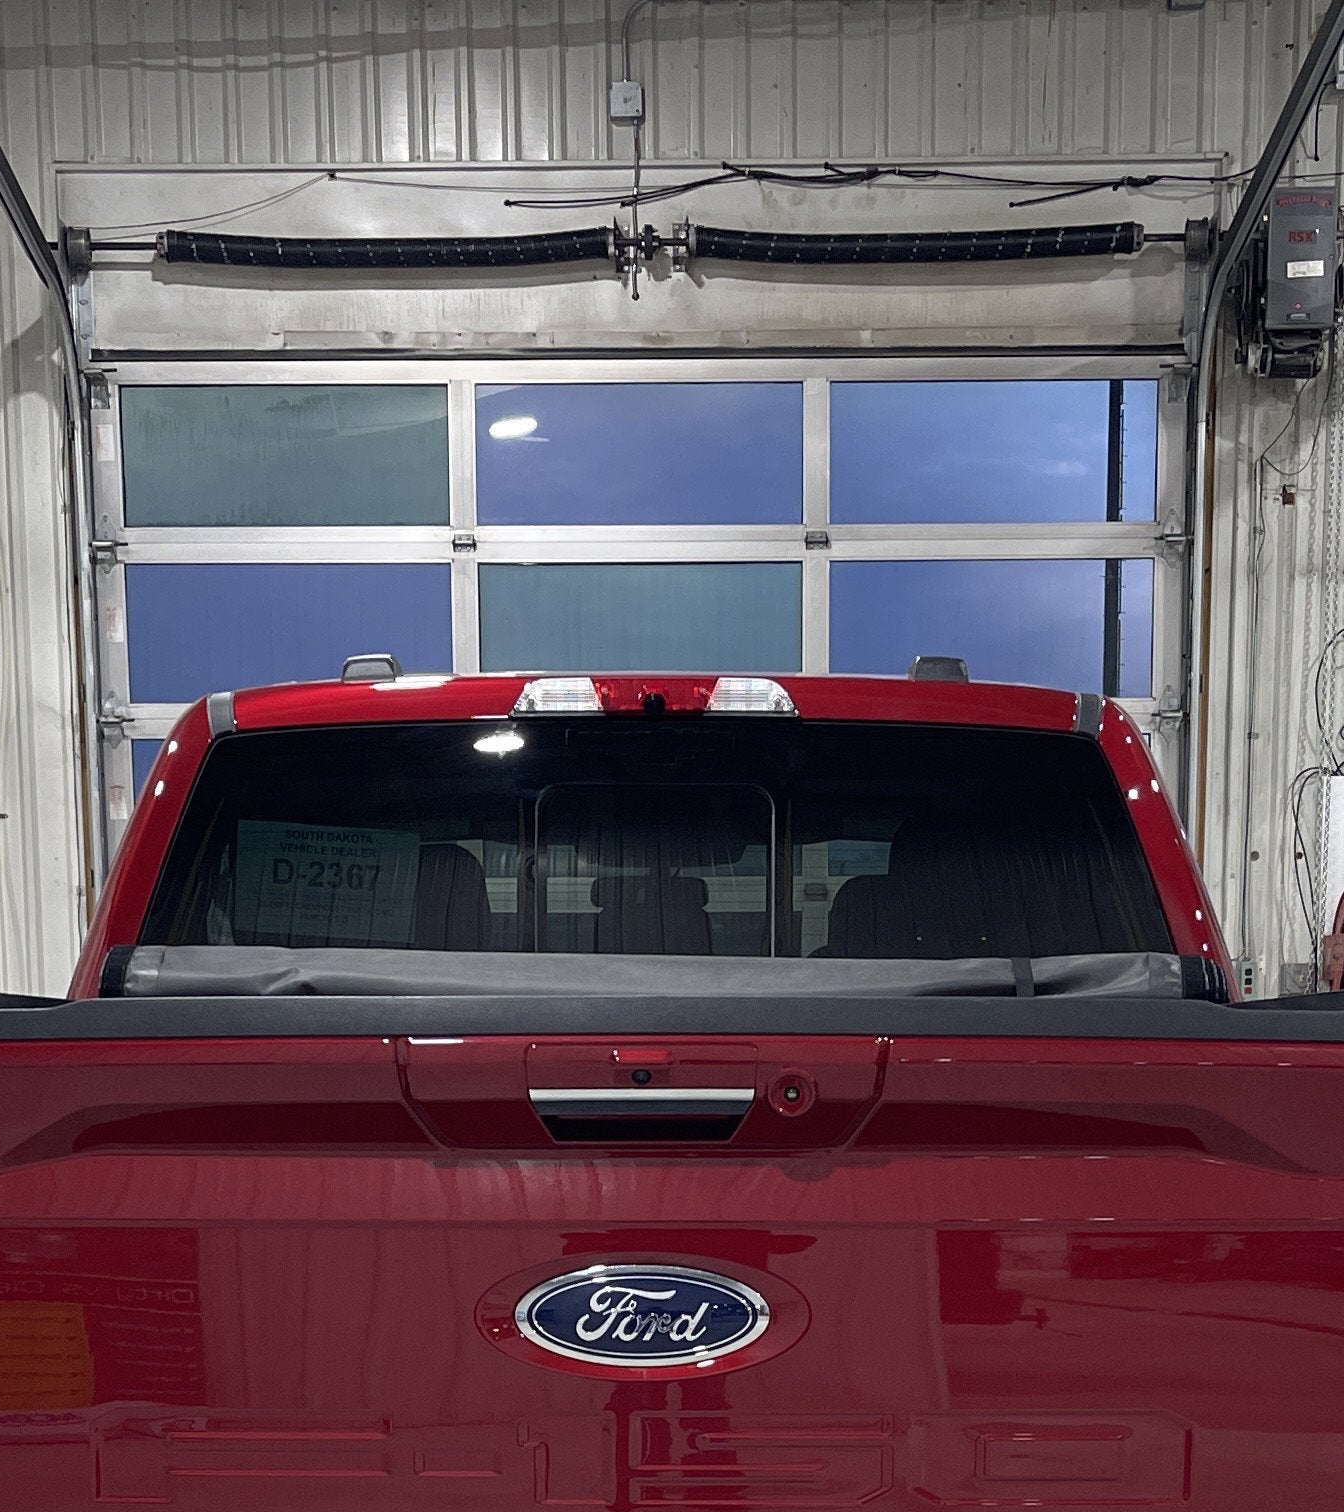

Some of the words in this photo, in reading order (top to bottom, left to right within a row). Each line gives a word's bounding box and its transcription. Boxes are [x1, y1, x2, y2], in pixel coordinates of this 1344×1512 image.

[285, 829, 324, 841] SOUTH
[327, 831, 374, 845] DAKOTA
[280, 842, 327, 856] VEHICLE
[330, 846, 376, 858] DEALER
[273, 858, 380, 891] D-2367
[576, 1286, 710, 1342] Ford
